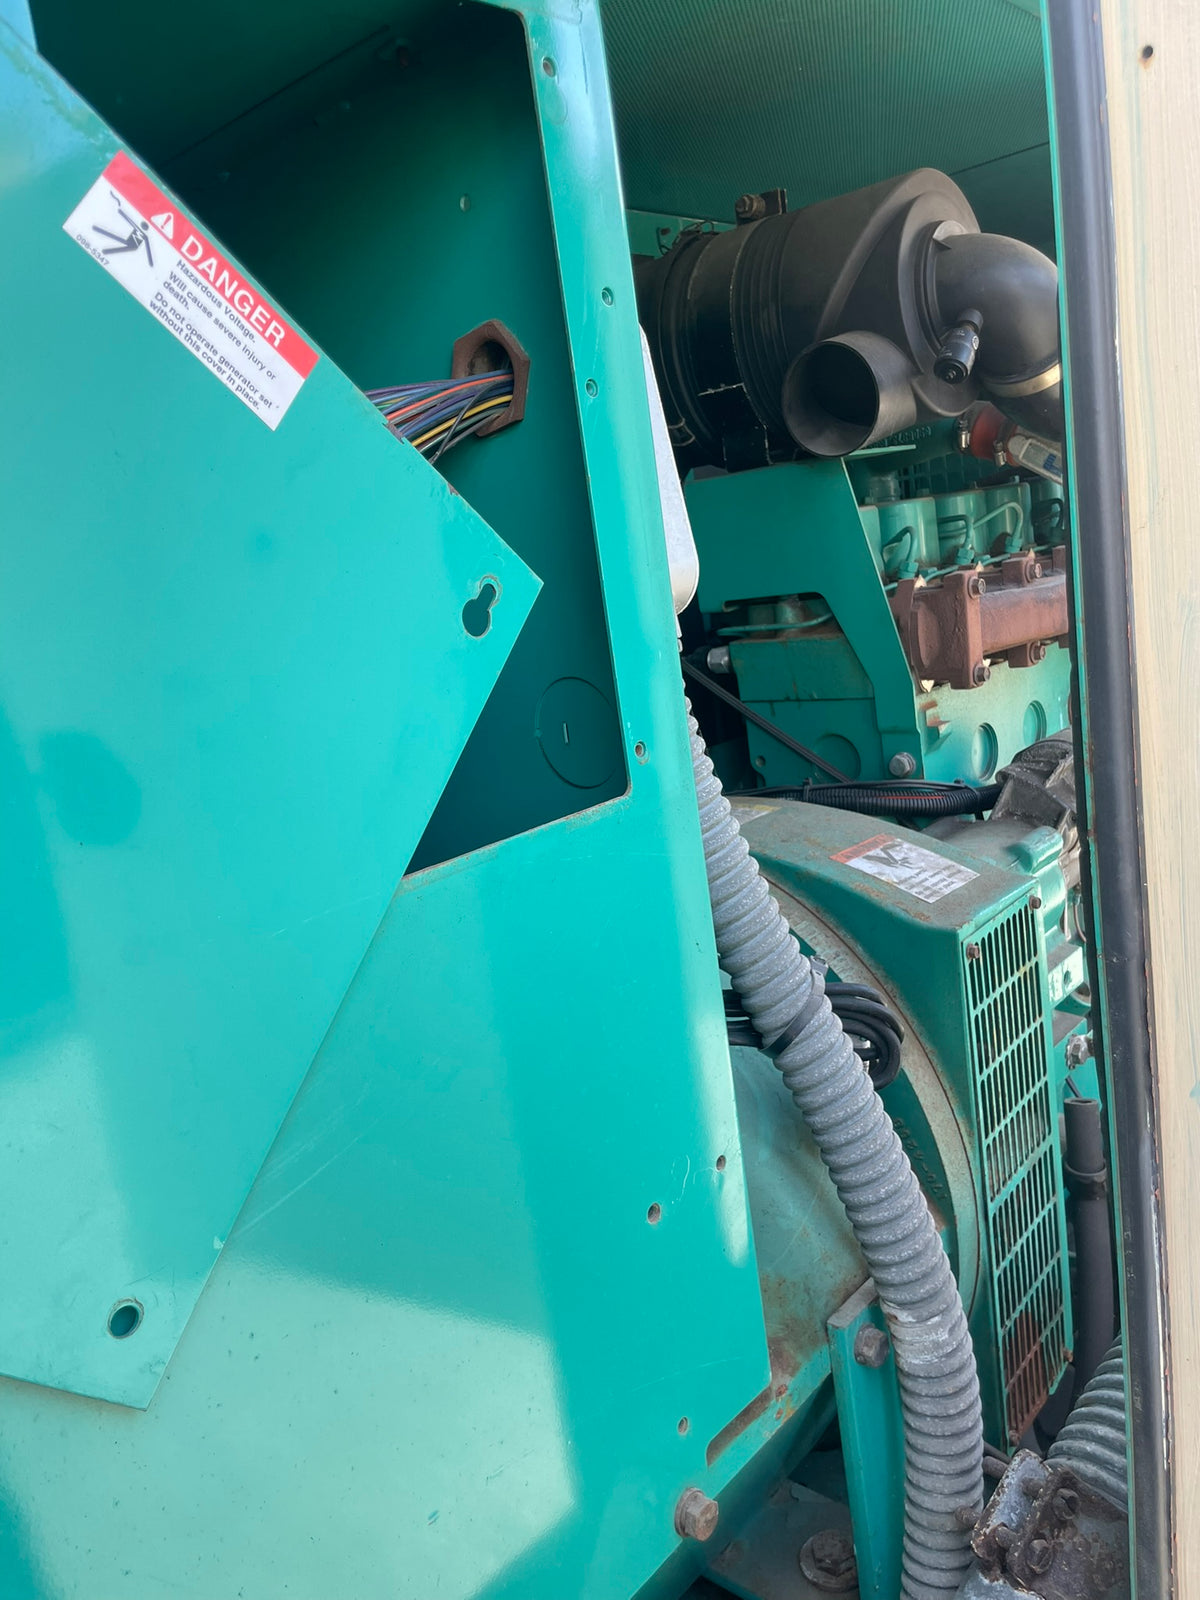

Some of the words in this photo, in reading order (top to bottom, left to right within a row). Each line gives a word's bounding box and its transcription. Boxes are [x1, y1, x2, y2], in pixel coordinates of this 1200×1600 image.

[163, 281, 189, 310] death.
[169, 271, 187, 292] Will
[186, 291, 213, 318] cause
[213, 317, 241, 347] severe
[242, 344, 266, 371] injury
[266, 370, 276, 380] or
[176, 259, 222, 308] Hazardous
[224, 306, 255, 343] Voltage.
[180, 235, 286, 348] DANGER
[150, 300, 183, 335] without
[184, 333, 201, 352] this
[201, 351, 226, 375] cover
[226, 373, 235, 386] in
[235, 384, 259, 410] place.
[154, 292, 168, 307] Do
[166, 305, 185, 324] not
[185, 323, 218, 356] operate
[218, 355, 259, 394] generator
[259, 394, 272, 408] set
